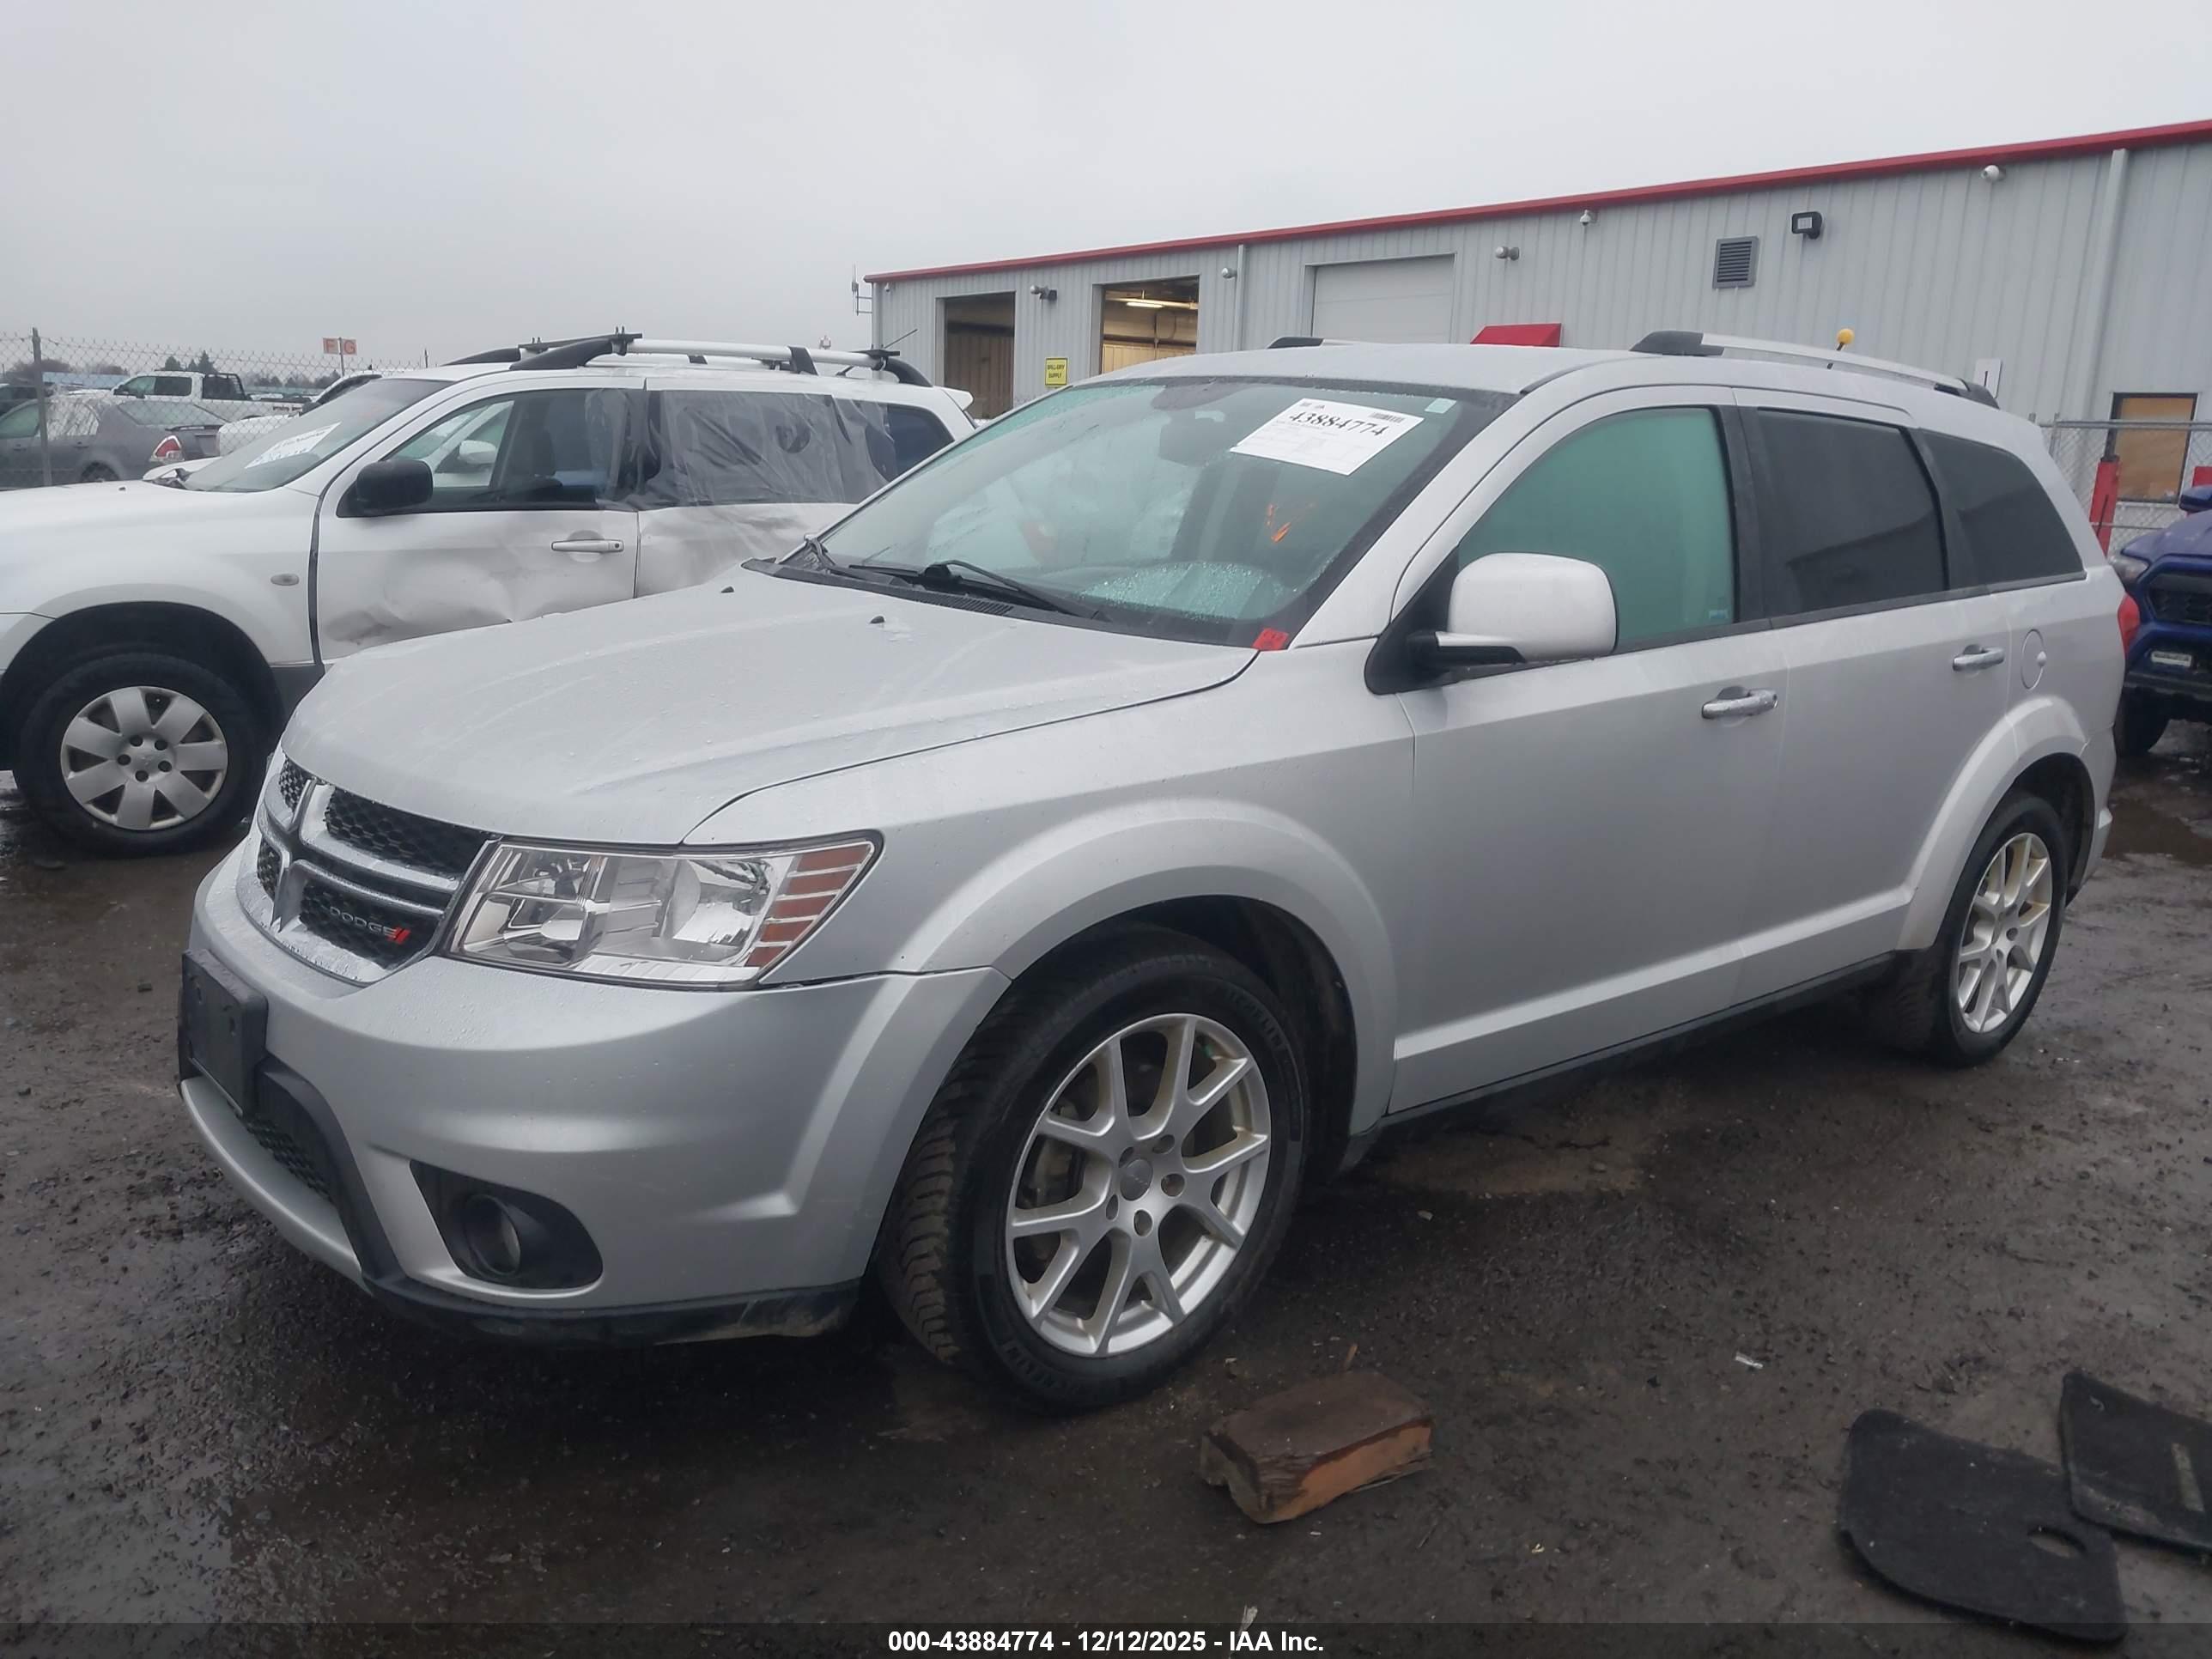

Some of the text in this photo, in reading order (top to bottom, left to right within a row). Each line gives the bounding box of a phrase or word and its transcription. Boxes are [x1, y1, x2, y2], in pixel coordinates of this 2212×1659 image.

[343, 339, 356, 355] G
[1290, 411, 1389, 436] 43884774
[329, 906, 398, 939] DODGE
